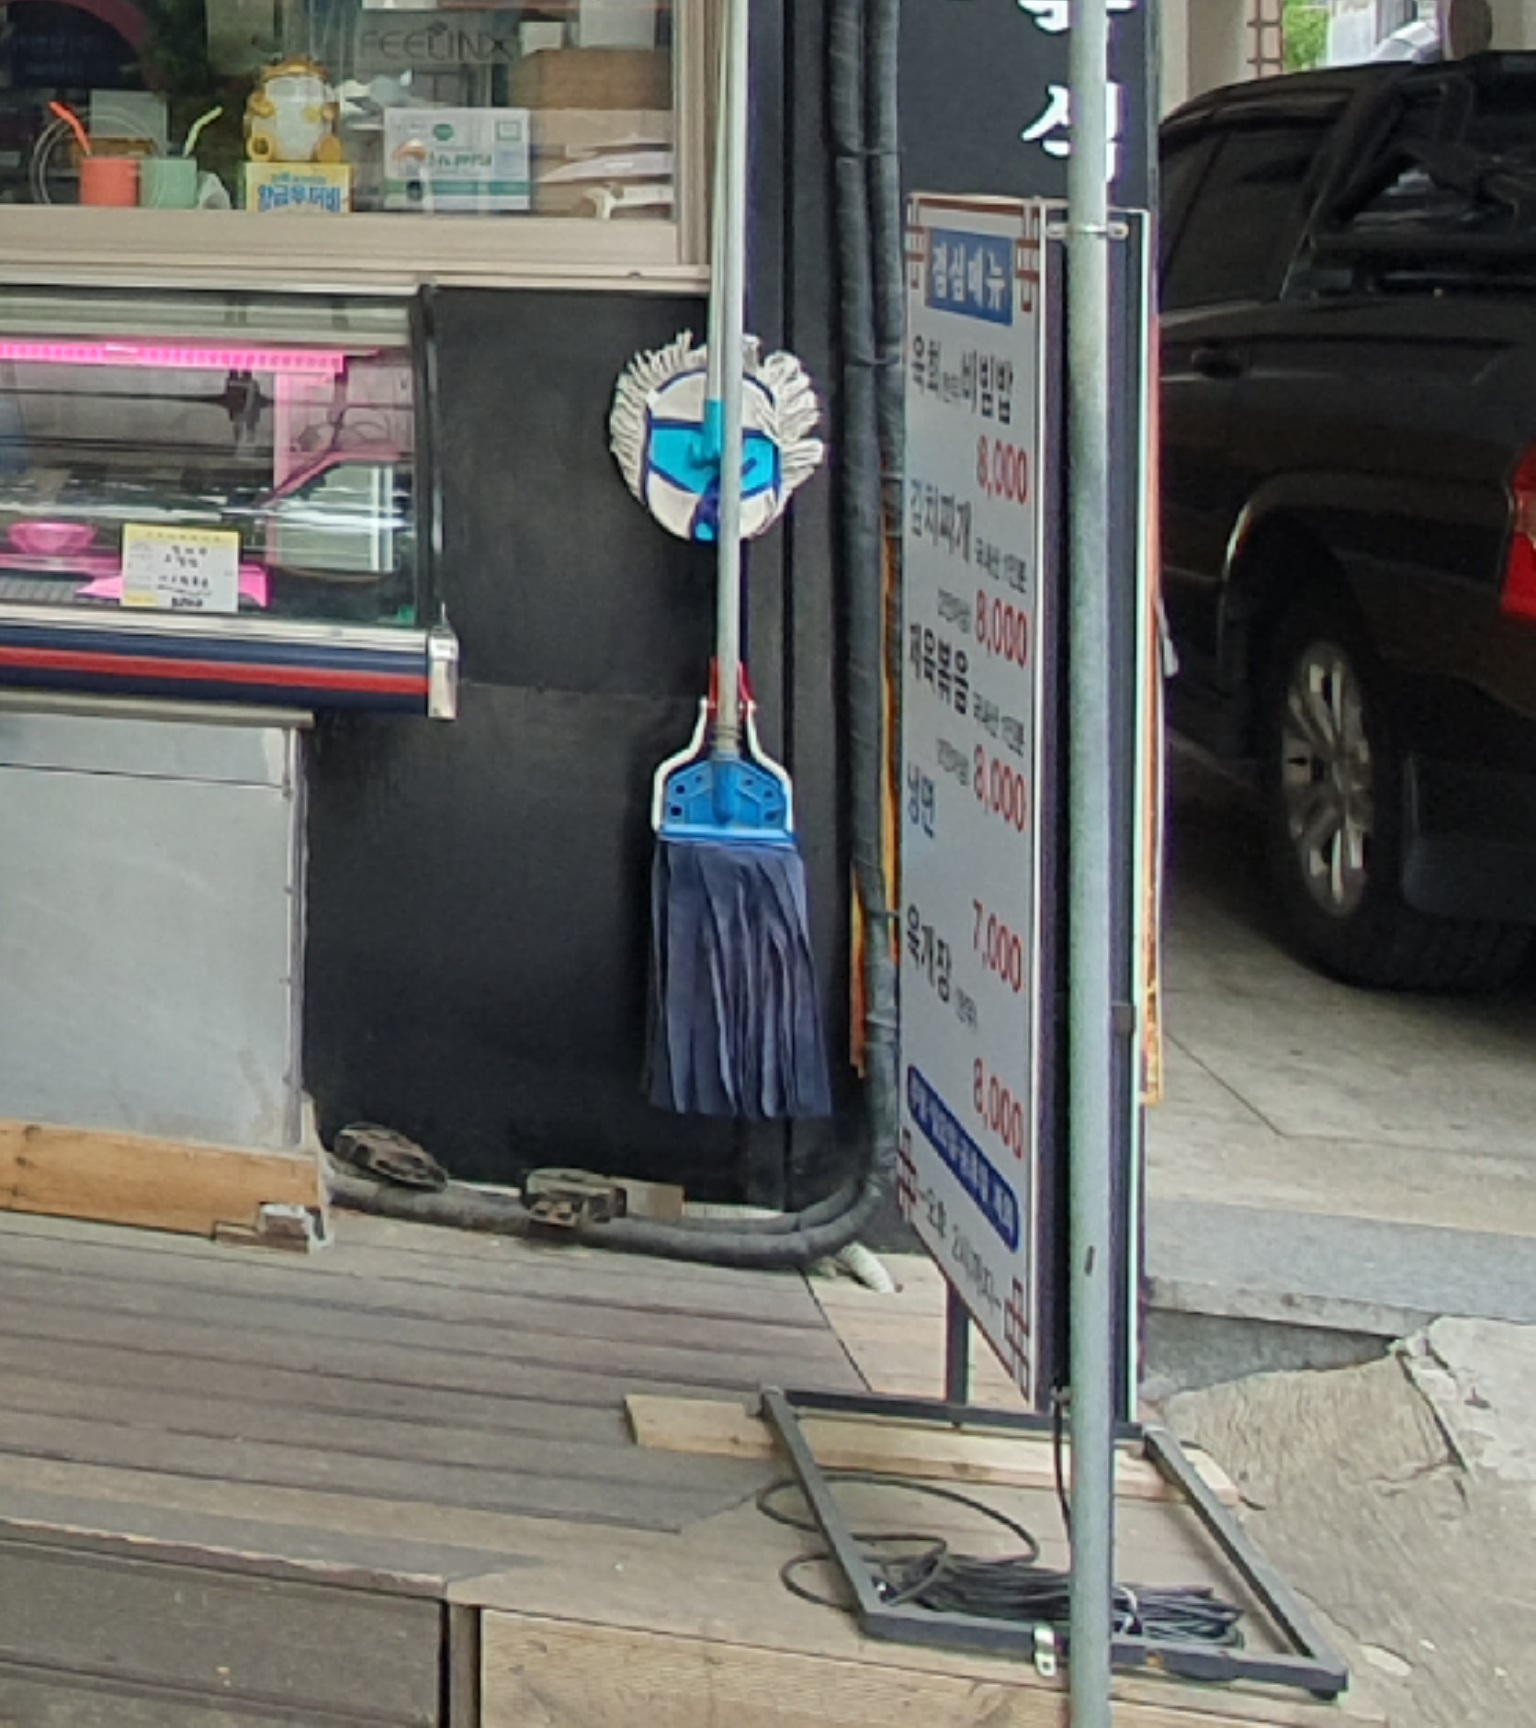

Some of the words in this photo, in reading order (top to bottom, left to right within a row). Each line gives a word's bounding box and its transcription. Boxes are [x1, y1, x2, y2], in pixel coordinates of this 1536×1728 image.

[929, 240, 1007, 313] 점심메뉴
[975, 435, 1028, 506] 8,000
[975, 589, 1028, 668] 8,000
[907, 763, 936, 839] 냉면
[973, 743, 1026, 832] 8,000
[906, 903, 952, 1004] 육개장
[973, 898, 1023, 993] 7,000
[973, 1057, 1025, 1159] 8,000
